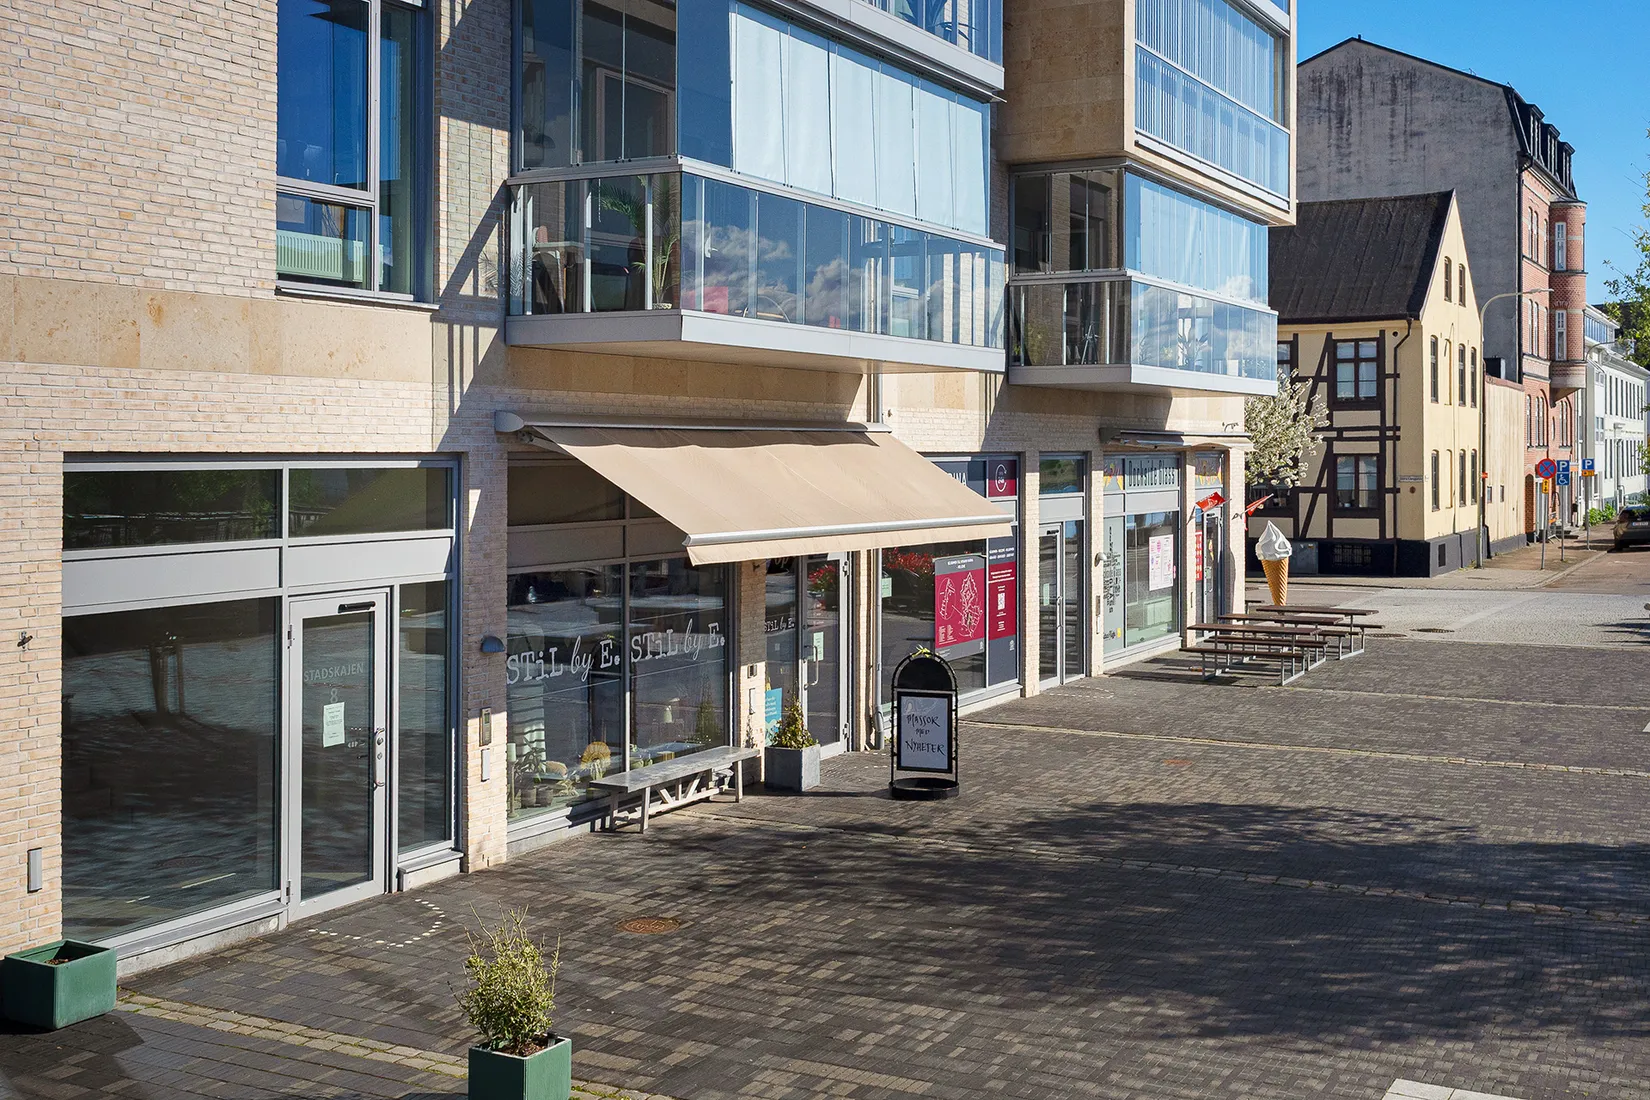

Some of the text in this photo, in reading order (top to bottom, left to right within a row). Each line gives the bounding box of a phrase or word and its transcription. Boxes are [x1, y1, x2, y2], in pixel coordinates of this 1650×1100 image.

[1128, 459, 1175, 487] Dockside Glass
[1560, 462, 1567, 472] P
[1585, 459, 1592, 469] P
[683, 618, 702, 661] by
[708, 622, 726, 649] E.
[570, 635, 595, 682] by
[600, 639, 621, 669] E.
[303, 663, 364, 682] STADSKAJEN
[330, 688, 338, 703] 8
